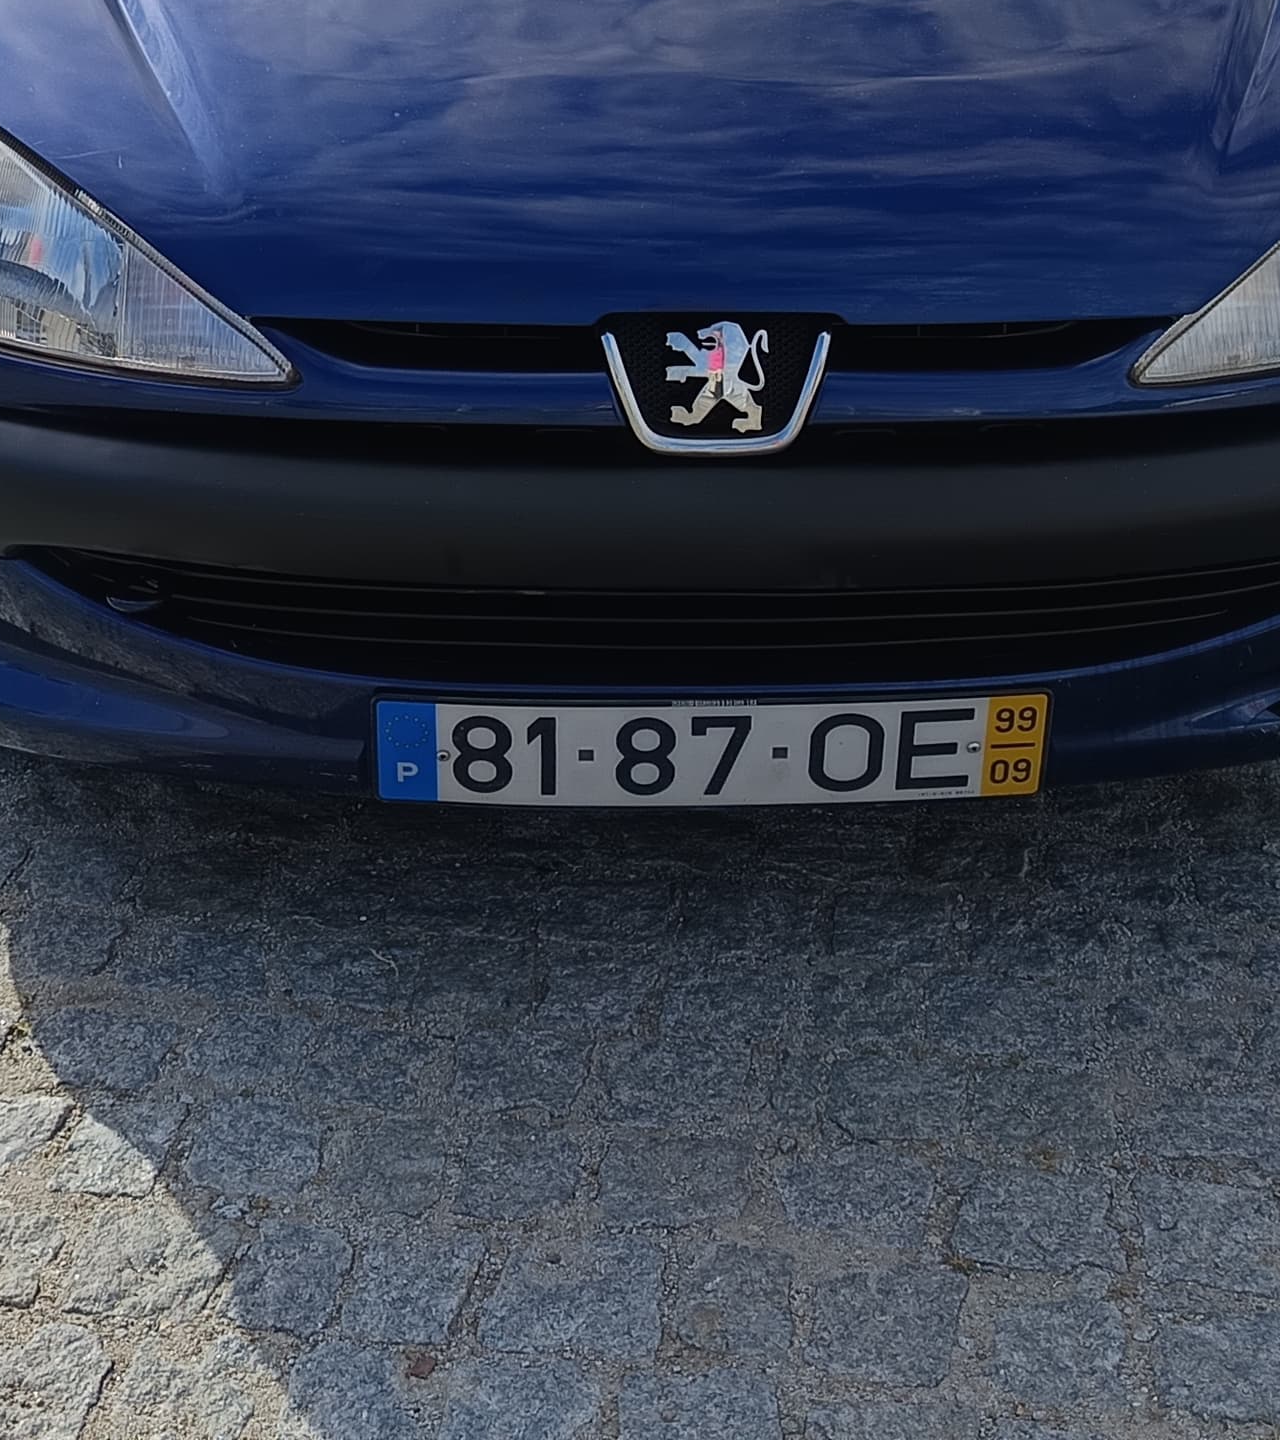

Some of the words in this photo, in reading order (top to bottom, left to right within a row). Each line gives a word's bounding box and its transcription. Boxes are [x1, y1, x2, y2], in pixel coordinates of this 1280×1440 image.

[994, 706, 1038, 733] 99
[397, 761, 419, 782] P
[989, 758, 1032, 784] 09
